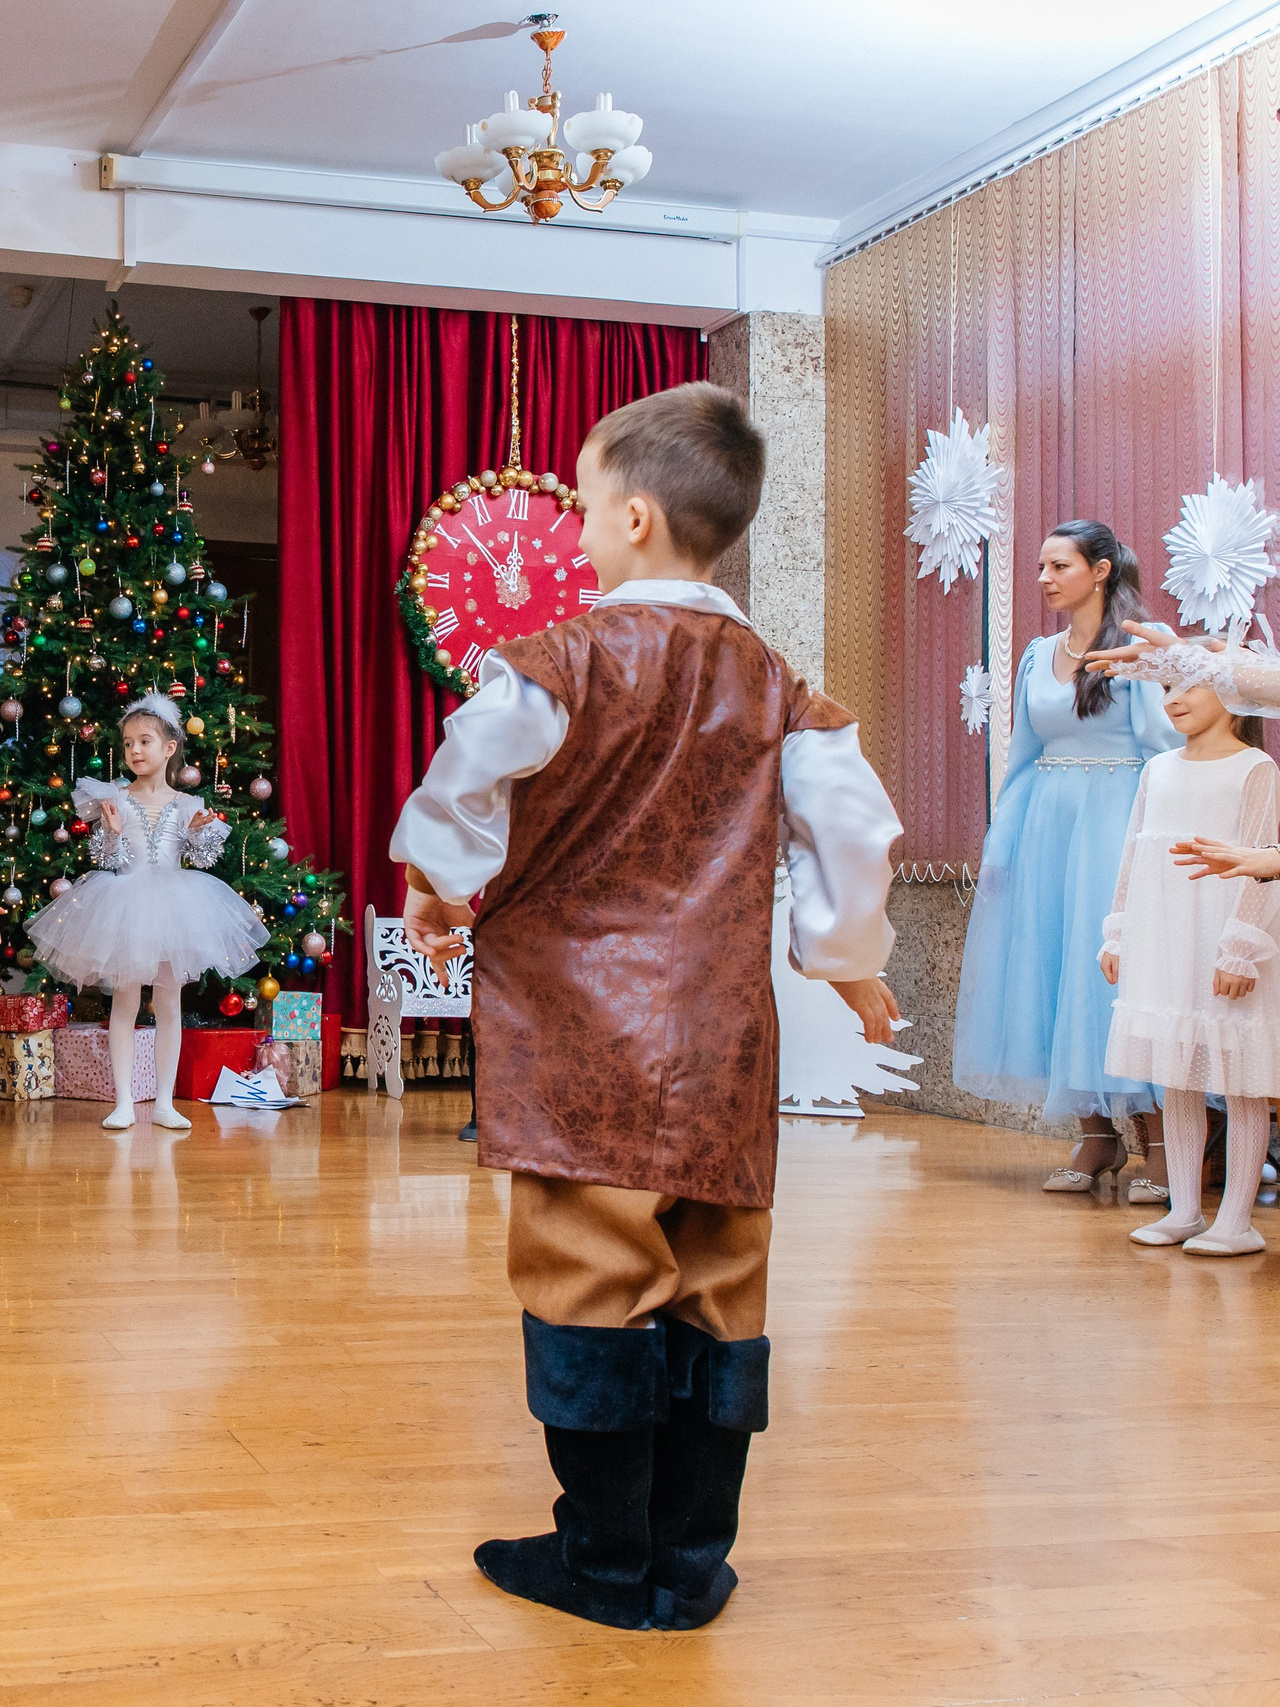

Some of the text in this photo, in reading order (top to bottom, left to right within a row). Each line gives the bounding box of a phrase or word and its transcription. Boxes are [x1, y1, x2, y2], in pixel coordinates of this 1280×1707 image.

[468, 494, 493, 527] XI
[506, 488, 530, 521] XII
[434, 523, 461, 549] X
